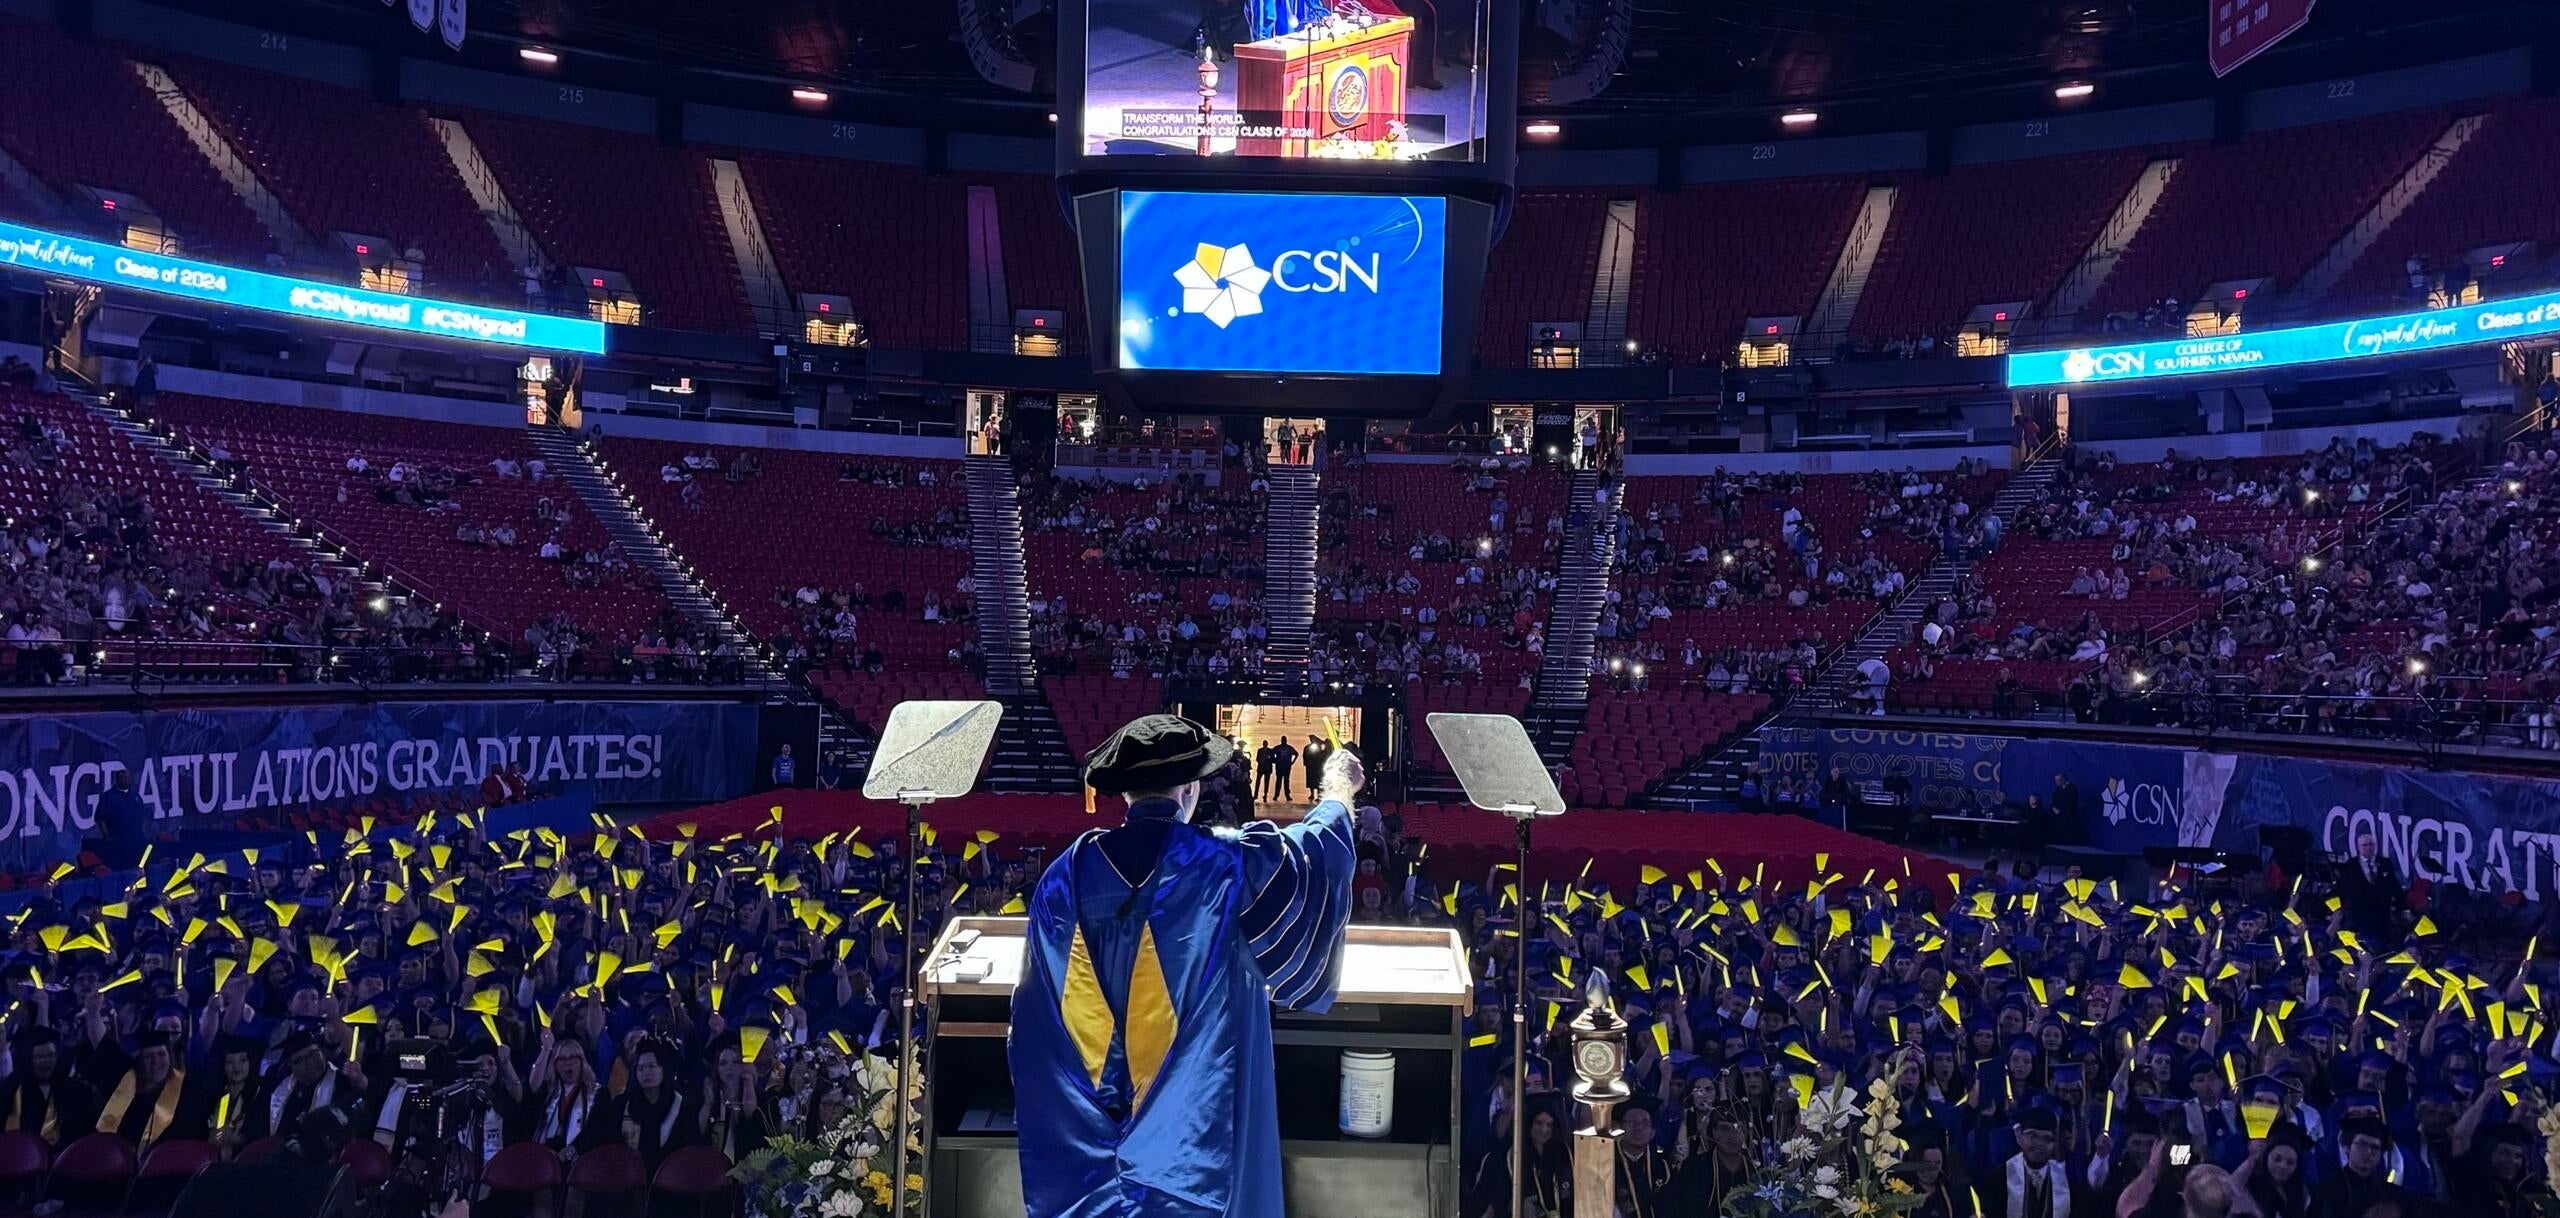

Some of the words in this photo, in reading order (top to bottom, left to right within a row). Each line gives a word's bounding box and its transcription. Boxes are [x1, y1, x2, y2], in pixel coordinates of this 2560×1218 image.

[261, 32, 287, 51] 214
[559, 87, 584, 104] 215
[2327, 80, 2355, 98] 222
[832, 123, 857, 139] 216
[1123, 113, 1184, 124] TRANSFORM
[1185, 113, 1205, 124] THE
[1206, 113, 1246, 124] WORLD.
[2025, 121, 2049, 137] 221
[1123, 126, 1216, 137] CONGRATULATIONS
[1218, 126, 1239, 137] CSN
[1240, 126, 1272, 138] CLASS
[1274, 127, 1288, 138] OF
[1752, 144, 1776, 160] 220
[115, 256, 160, 280] Class
[161, 268, 178, 284] of
[180, 268, 228, 292] 2024
[1272, 249, 1380, 294] CSN
[289, 287, 411, 323] #CSNproud
[422, 306, 527, 338] #CSNgrad
[2478, 312, 2524, 330] Class
[2526, 304, 2545, 323] of
[2095, 351, 2146, 375] CSN
[387, 734, 663, 791] GRADUATES!
[1829, 751, 1966, 781] COYOTES
[0, 741, 379, 842] ONGATULATIONS
[2131, 783, 2181, 828] CSN
[2323, 805, 2560, 902] CONGRAT
